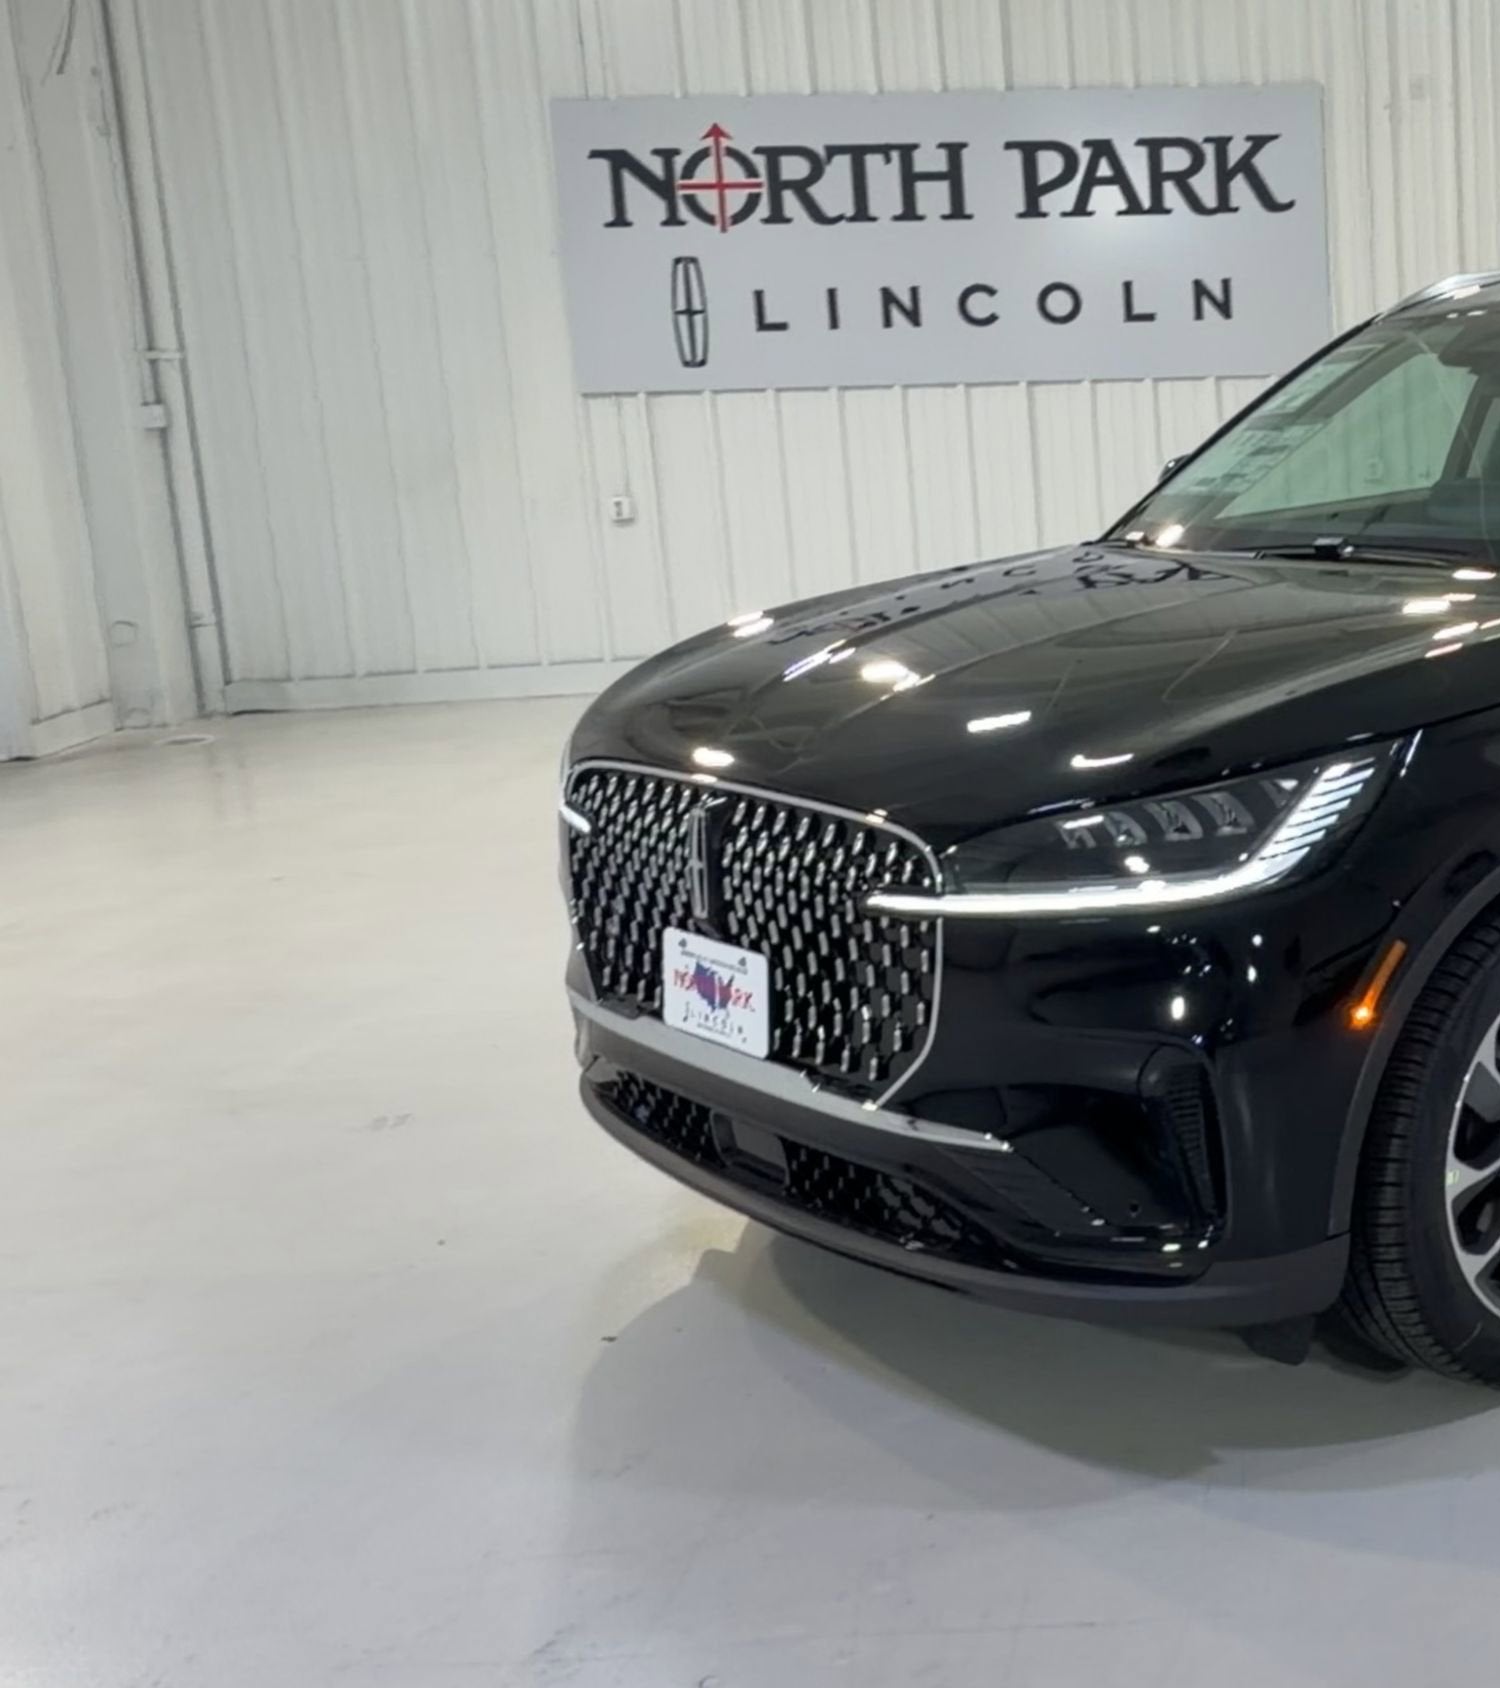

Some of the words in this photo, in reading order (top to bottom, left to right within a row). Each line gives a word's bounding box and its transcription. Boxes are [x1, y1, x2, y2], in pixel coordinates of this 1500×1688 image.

[588, 136, 974, 229] NORTH
[1004, 135, 1294, 218] PARK
[754, 279, 1231, 331] LINCOLN
